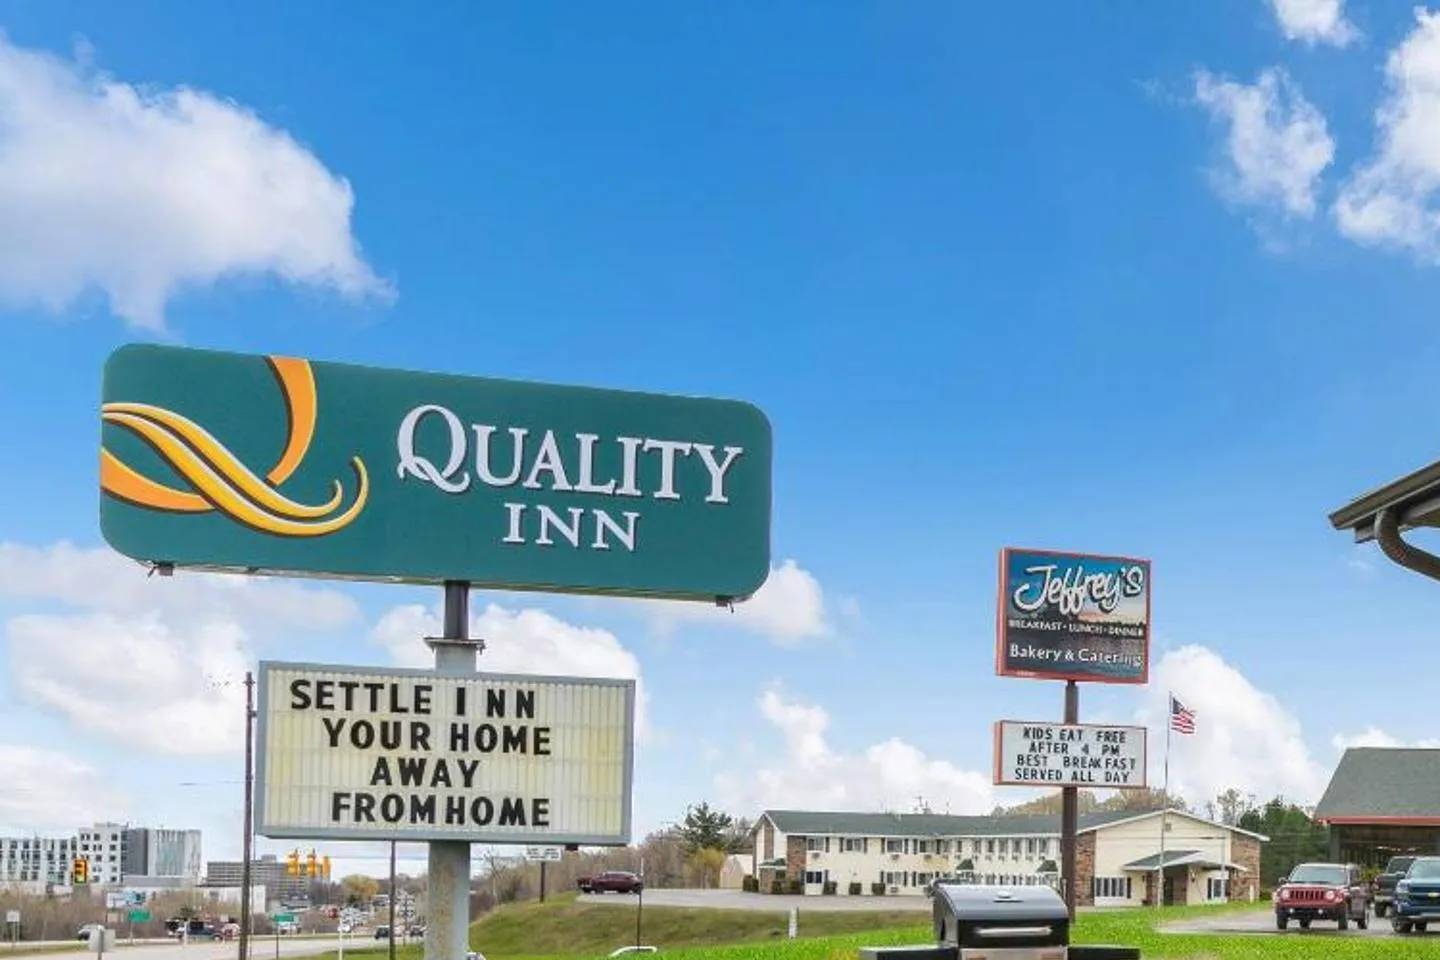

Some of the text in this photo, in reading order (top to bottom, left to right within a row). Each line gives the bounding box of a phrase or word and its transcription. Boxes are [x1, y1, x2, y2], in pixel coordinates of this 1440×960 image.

[397, 404, 743, 503] QUALITY
[502, 503, 640, 551] INN
[1008, 619, 1062, 631] BREAKFAST
[1068, 623, 1103, 634] LUNCH
[1010, 643, 1142, 667] Bakery & Catering
[290, 679, 432, 715] SETTLE
[322, 718, 551, 755] YOUR HOME
[1022, 726, 1127, 744] KIDS EAT FREE
[1028, 741, 1120, 756] AFTER 4 PM
[370, 756, 480, 788] AWAY
[1017, 754, 1048, 767] BEST
[1015, 768, 1130, 783] SERVED ALL DAY
[332, 793, 550, 826] FROM HOME
